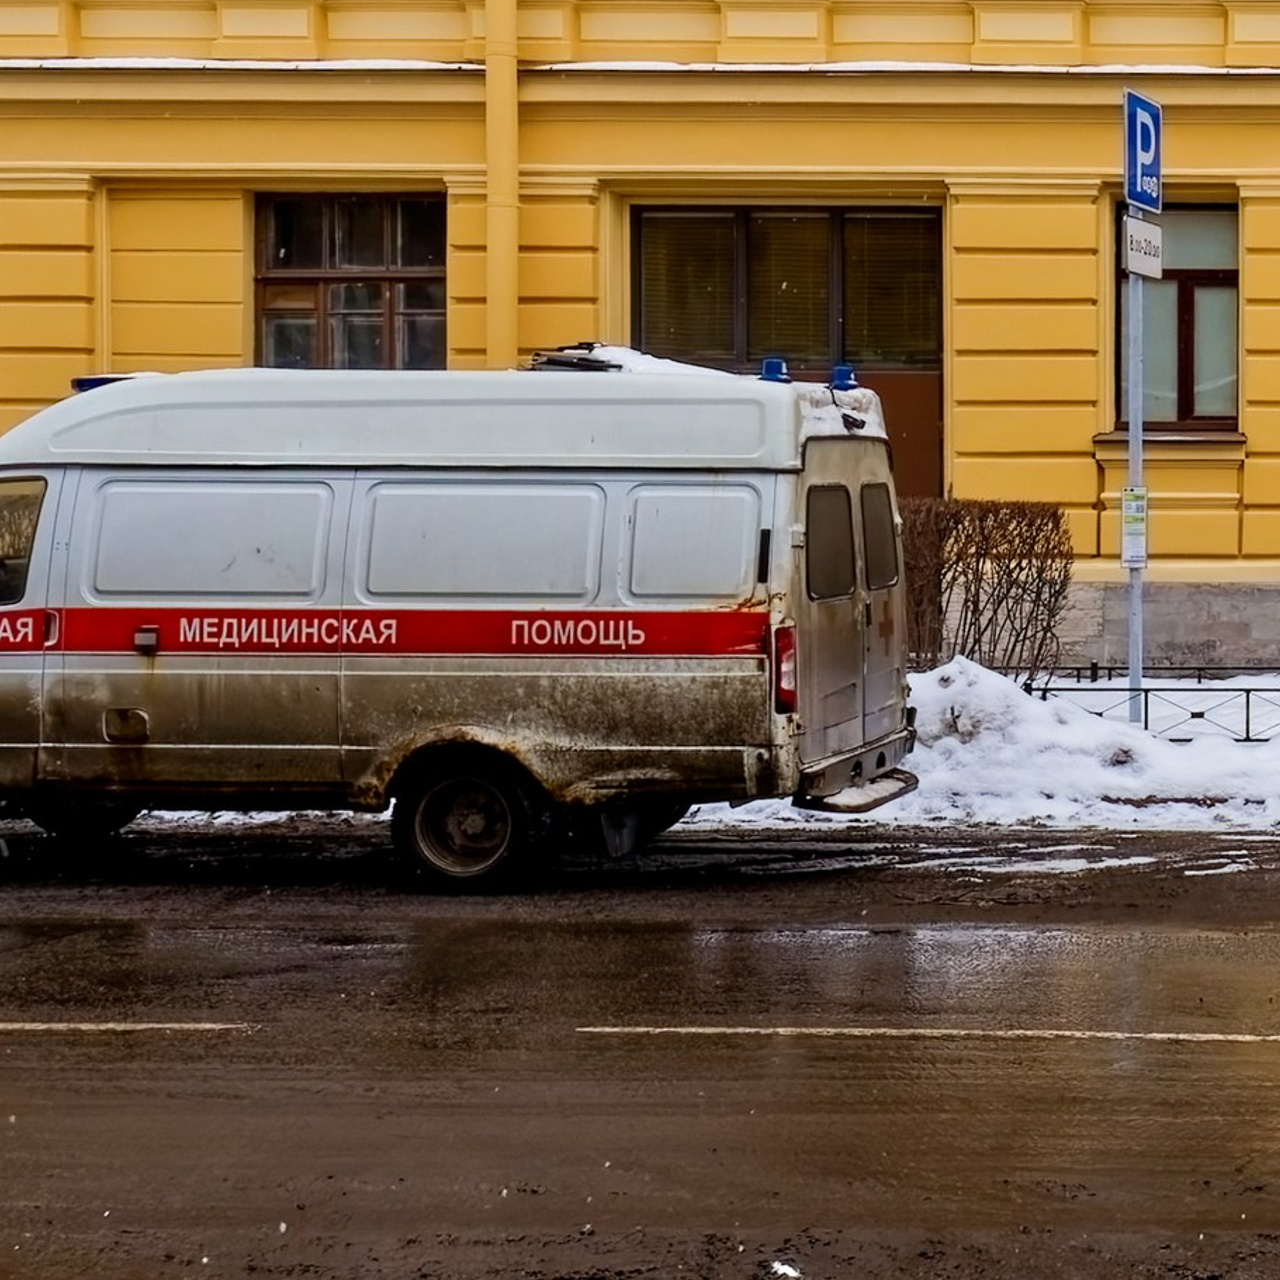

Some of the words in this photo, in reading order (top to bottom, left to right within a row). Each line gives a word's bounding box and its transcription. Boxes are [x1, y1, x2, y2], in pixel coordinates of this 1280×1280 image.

[1136, 107, 1156, 192] P
[179, 617, 398, 648] МЕДИЦИНСКАЯ
[511, 619, 646, 650] ПОМОЩЬ
